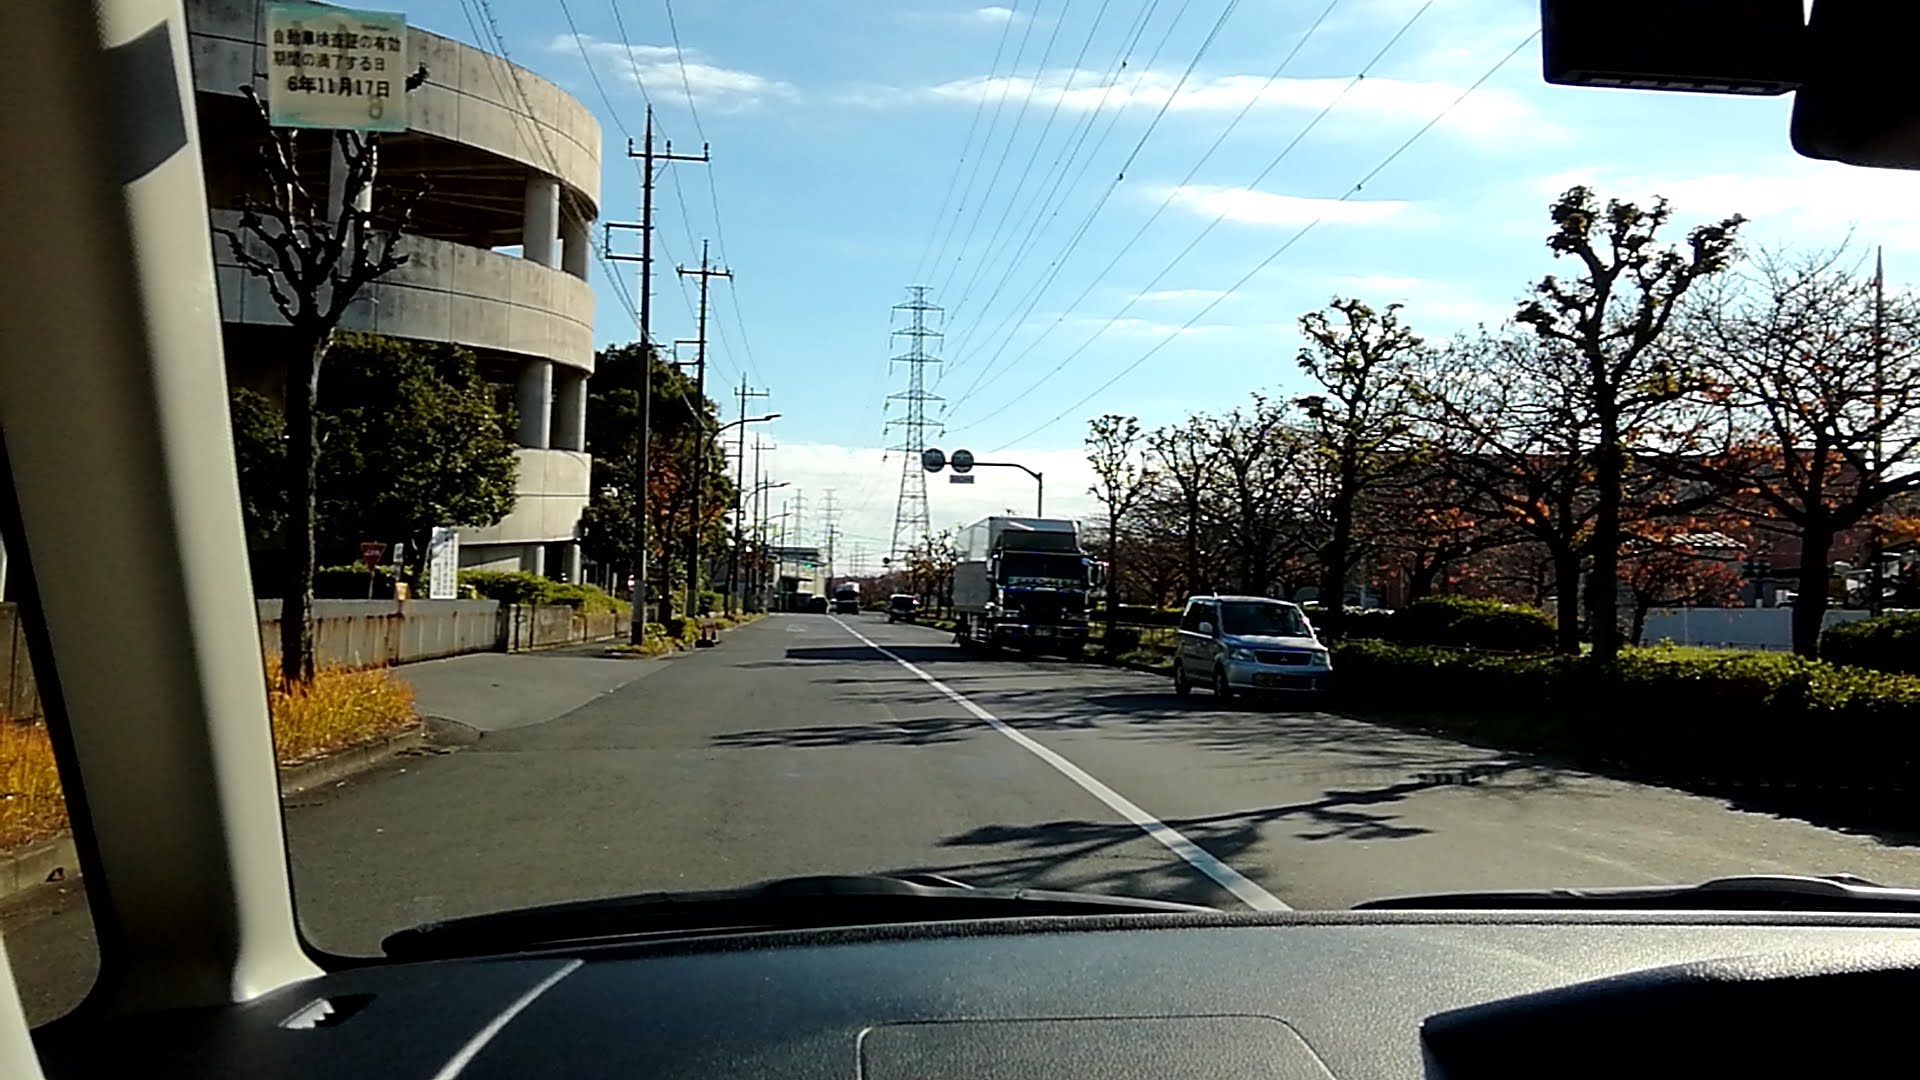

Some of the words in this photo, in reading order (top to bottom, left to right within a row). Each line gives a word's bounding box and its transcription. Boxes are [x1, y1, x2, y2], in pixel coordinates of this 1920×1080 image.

[274, 29, 401, 52] 自動車検査証の有効
[274, 52, 385, 71] 期間の満了する日
[288, 77, 390, 98] 6年11月17日
